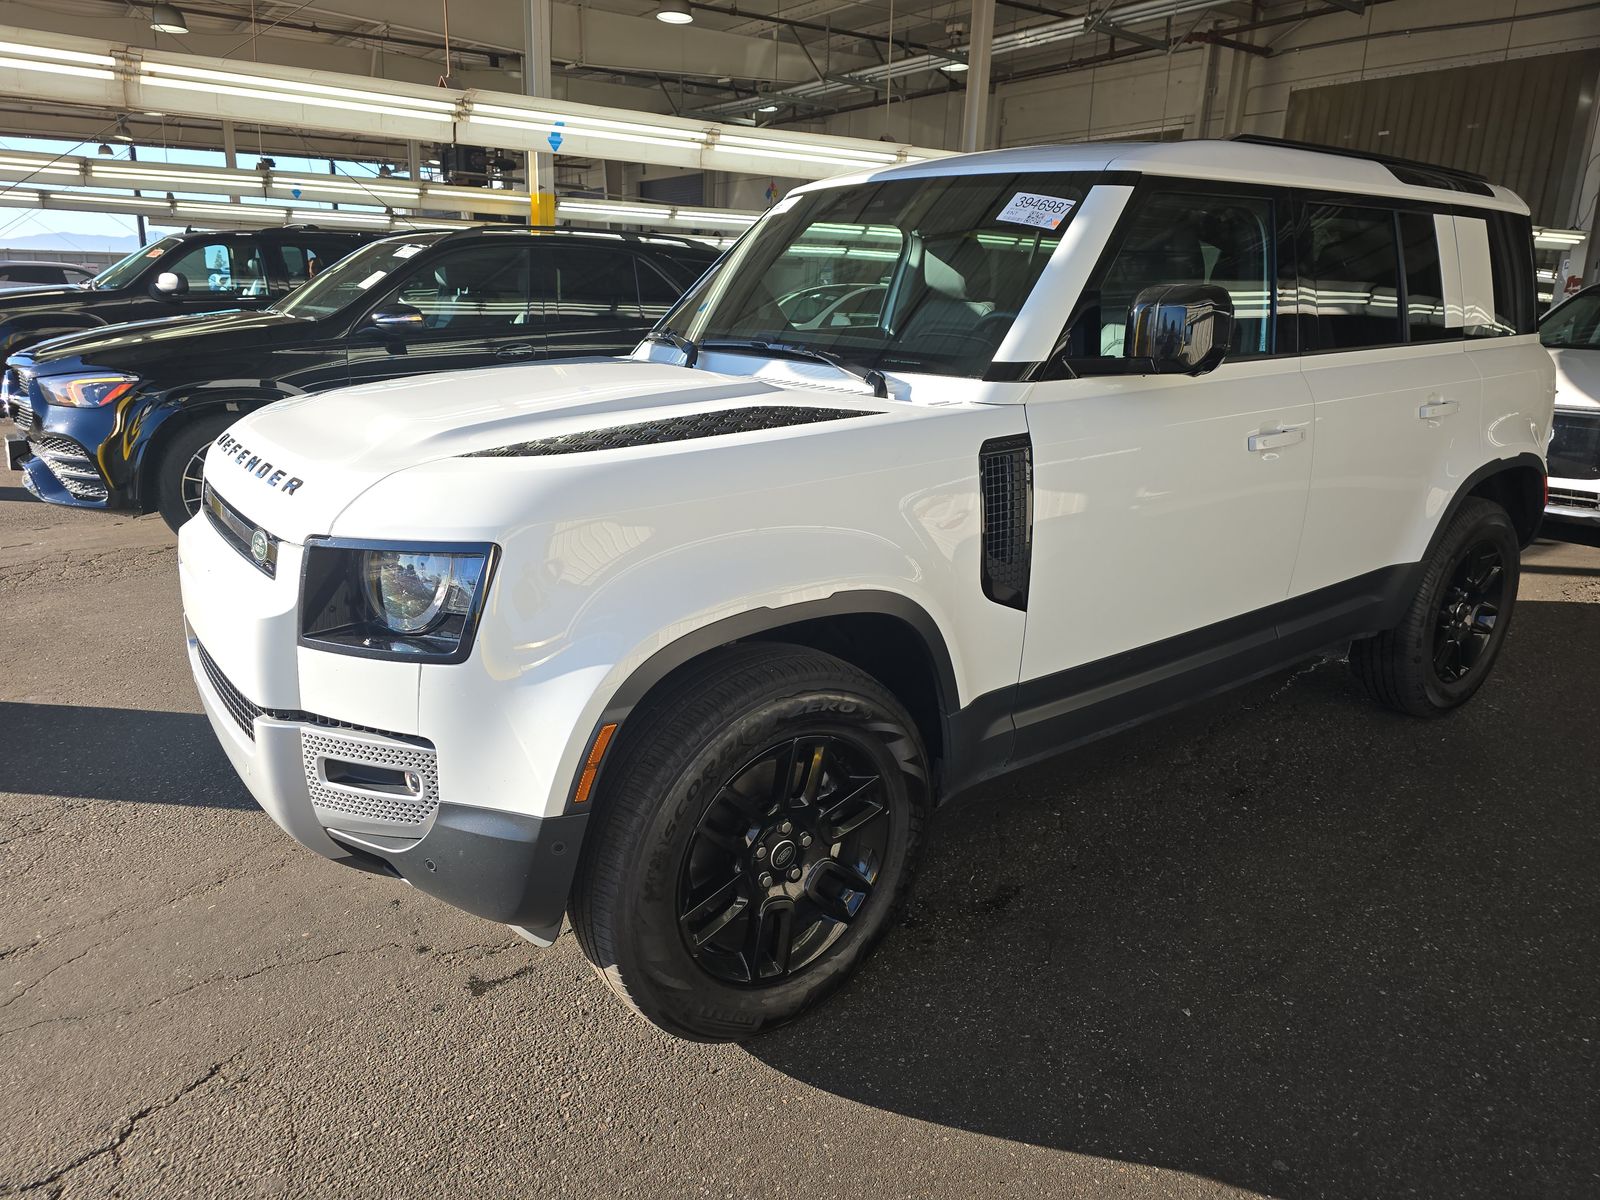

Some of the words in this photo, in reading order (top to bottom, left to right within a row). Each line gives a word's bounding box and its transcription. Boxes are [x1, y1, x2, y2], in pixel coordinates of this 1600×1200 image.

[1015, 196, 1073, 215] 3946987
[217, 433, 304, 496] DEFENDER
[664, 715, 774, 838] SCORPIO
[793, 701, 857, 716] ZERO
